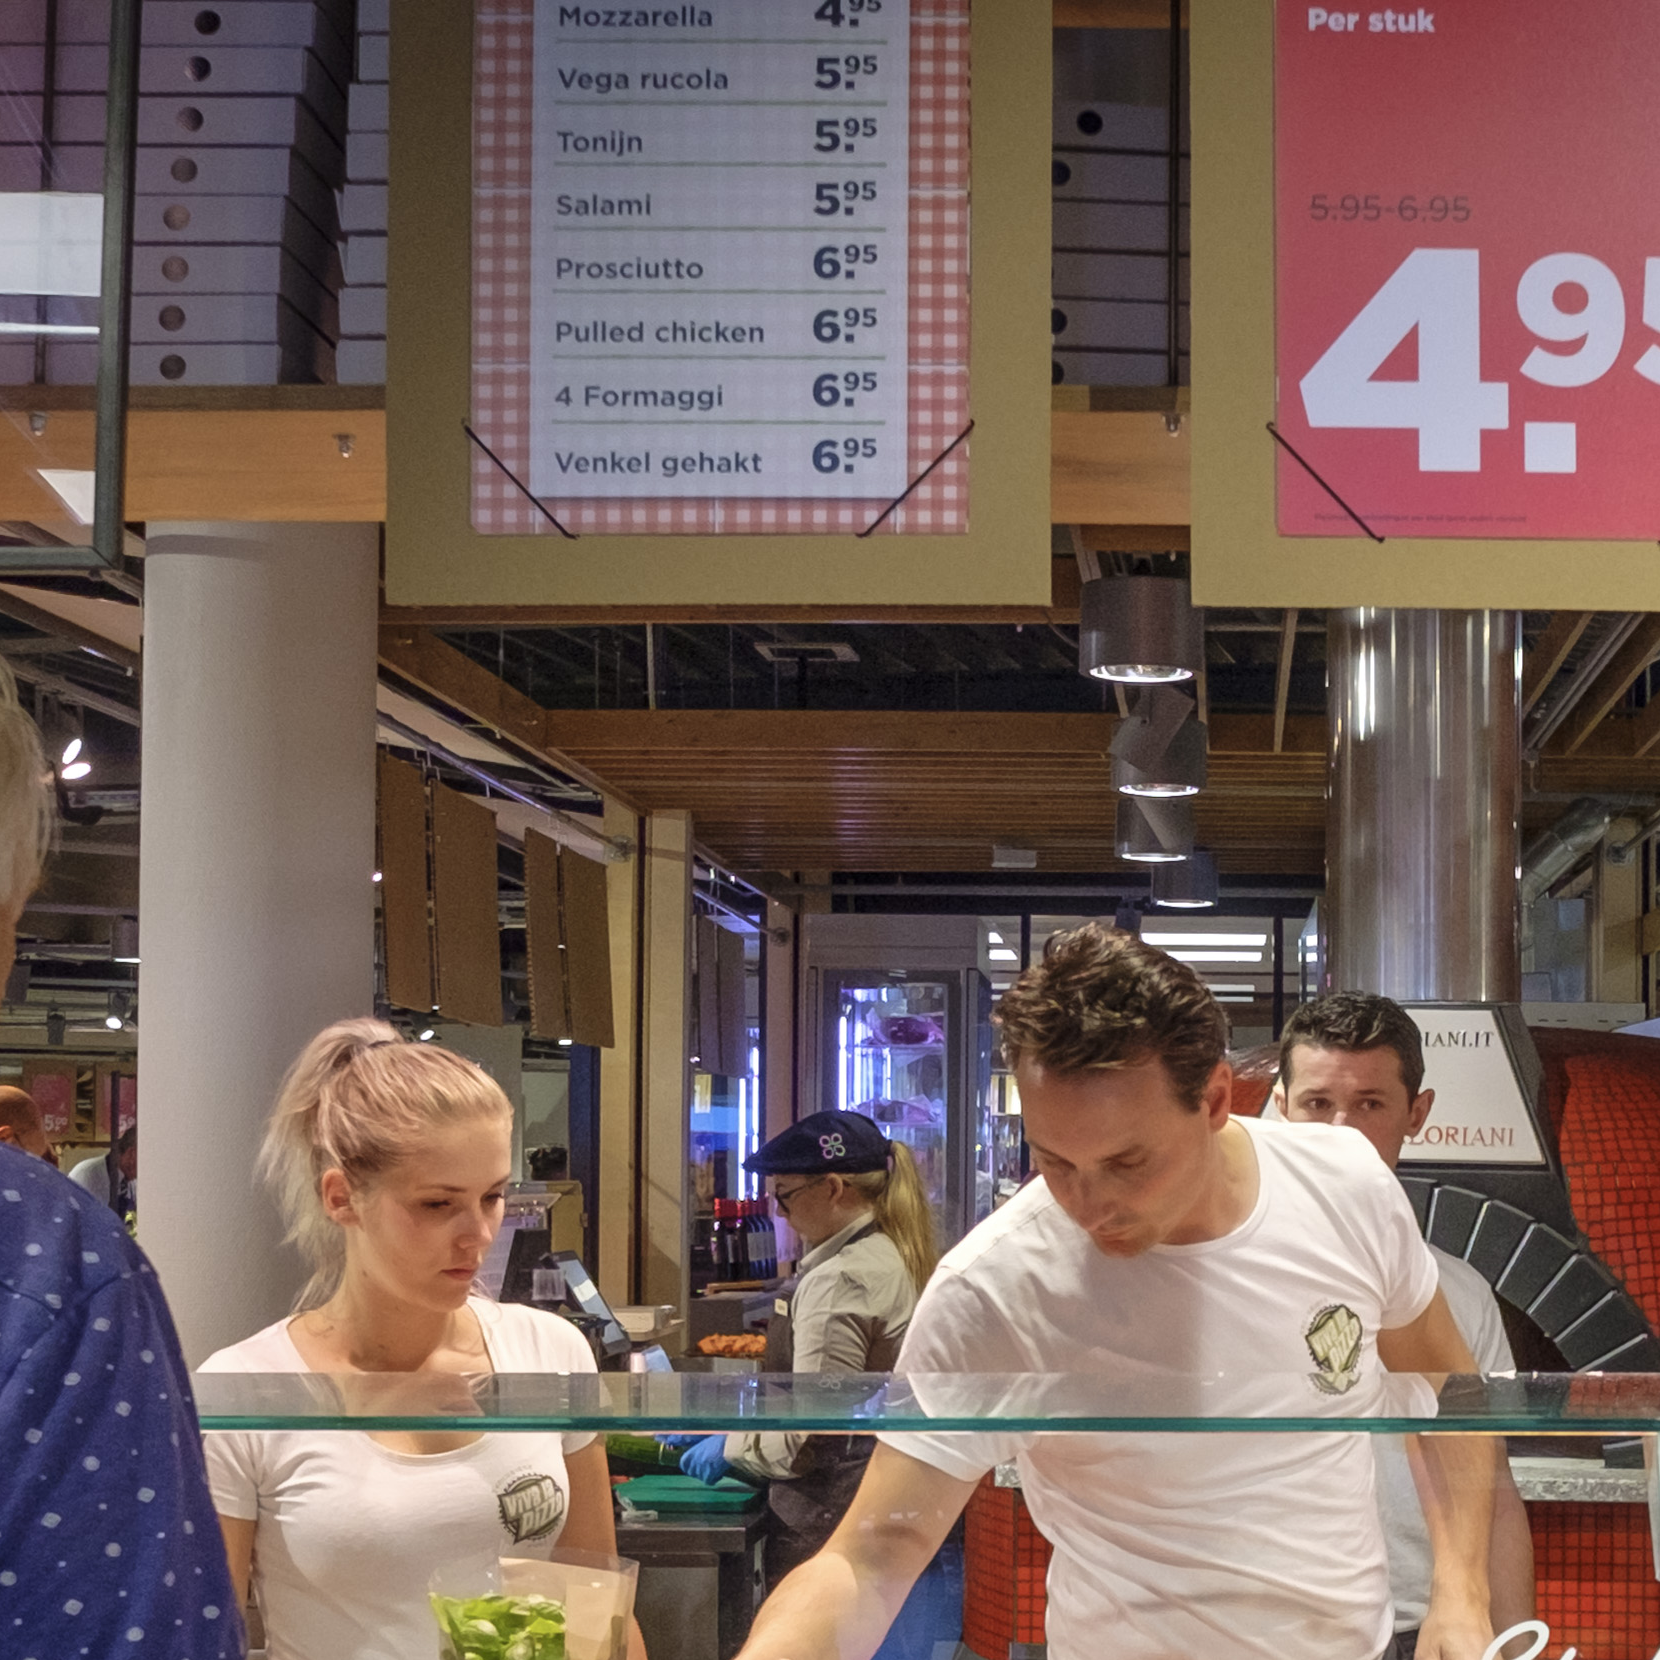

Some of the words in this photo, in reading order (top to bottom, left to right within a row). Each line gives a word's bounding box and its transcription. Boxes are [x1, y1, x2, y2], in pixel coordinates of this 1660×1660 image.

[559, 5, 712, 27] Mozzarella
[1308, 7, 1359, 32] Per
[1368, 7, 1435, 33] stuk
[557, 68, 629, 94] Vega
[641, 67, 728, 91] rucola
[815, 55, 878, 90] 5.95
[557, 131, 643, 156] Tonijn
[814, 118, 877, 153] 5.95
[556, 193, 651, 217] Salami
[814, 181, 877, 216] 5.95
[556, 258, 704, 281] Prosciutto
[813, 245, 878, 280] 6.95
[556, 321, 644, 344] Pulled
[655, 321, 765, 344] chicken
[813, 308, 878, 343] 6.95
[555, 386, 572, 407] 4
[584, 385, 723, 411] Formaggi
[813, 372, 878, 408] 6.95
[555, 452, 651, 474] Venkel
[662, 452, 763, 477] gehakt
[812, 438, 878, 474] 6.95
[1424, 1031, 1494, 1048] IANI.IT
